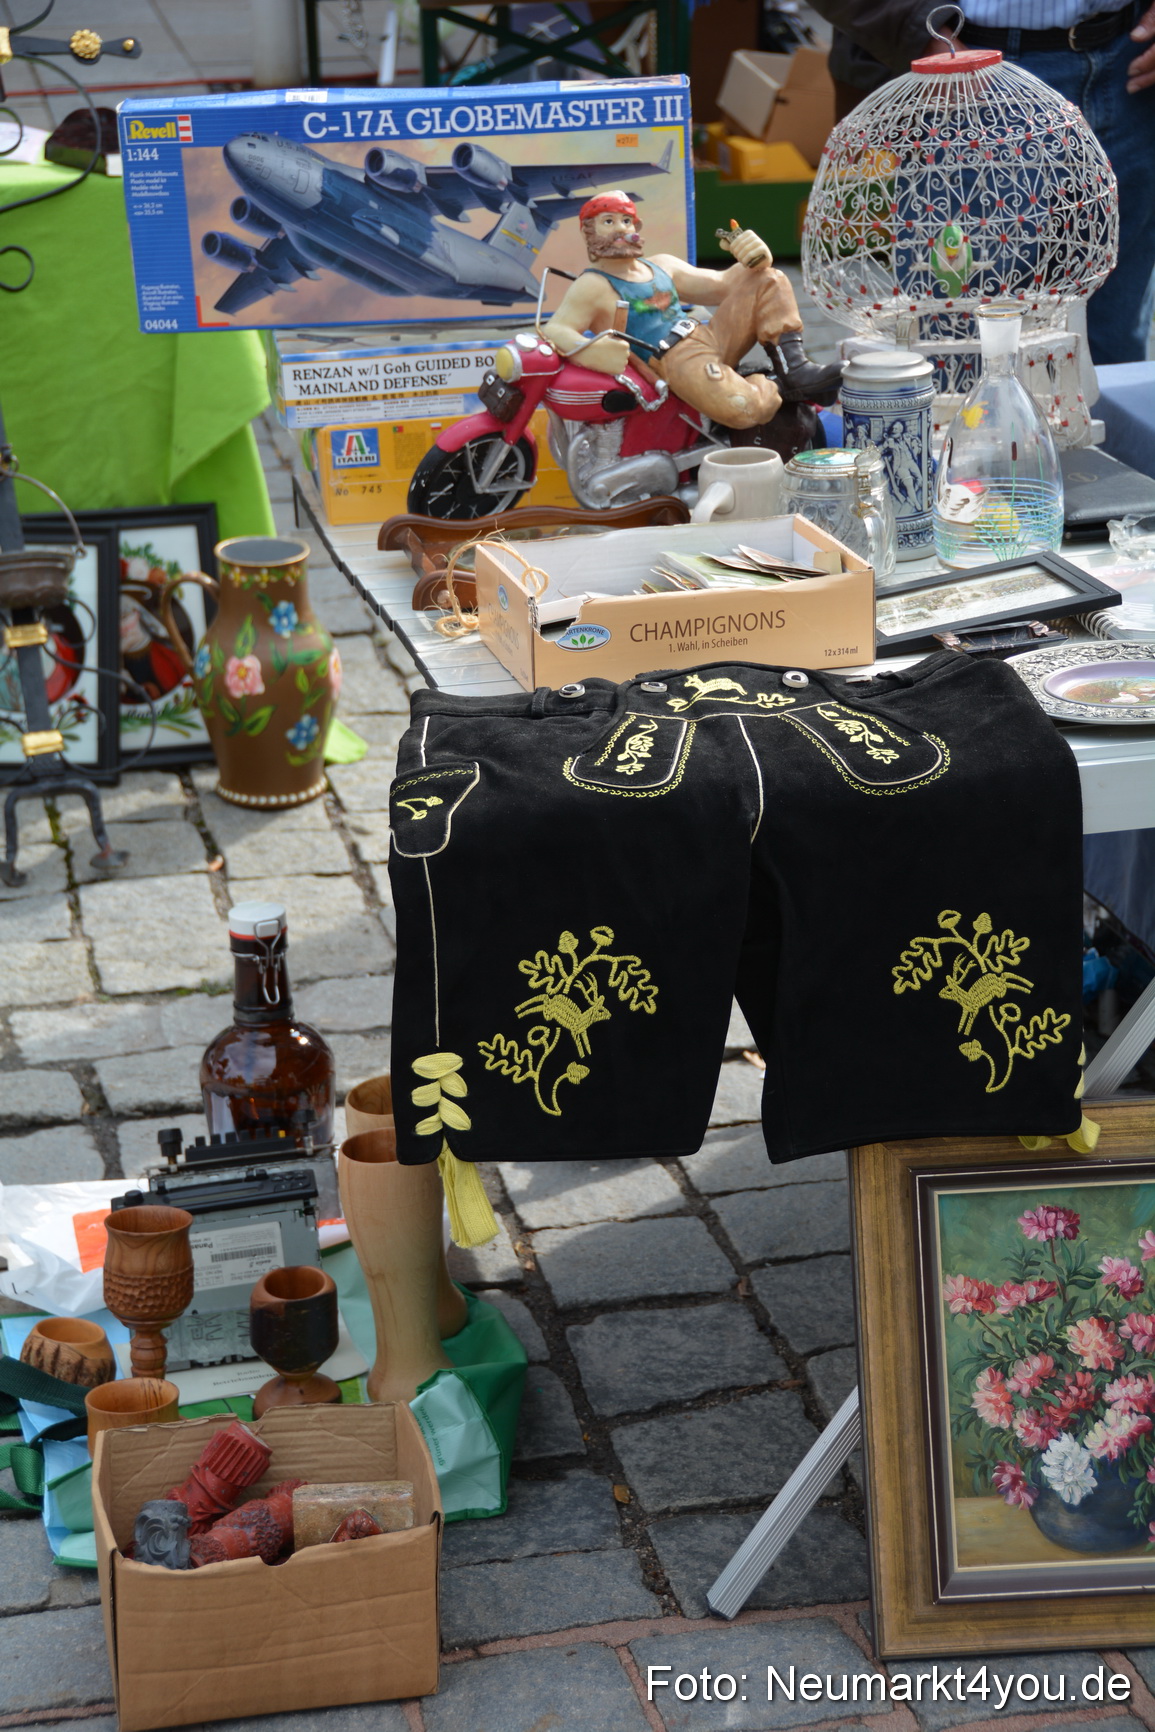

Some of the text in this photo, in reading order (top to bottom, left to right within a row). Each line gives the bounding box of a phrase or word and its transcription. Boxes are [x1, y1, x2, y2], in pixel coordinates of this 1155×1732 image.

[303, 95, 684, 140] C-17A GLOBEMASTER III
[128, 120, 177, 139] Revell
[126, 148, 159, 161] 1:144
[145, 319, 178, 330] 04044
[292, 355, 496, 381] RENZAN w/I Goh GUIDED BO
[337, 455, 376, 464] ITALERI
[335, 485, 383, 496] No 745
[565, 626, 606, 636] ARTENKRONE
[629, 610, 786, 643] CHAMPIGNONS
[668, 636, 748, 653] 1. Wahl, in Scheiben
